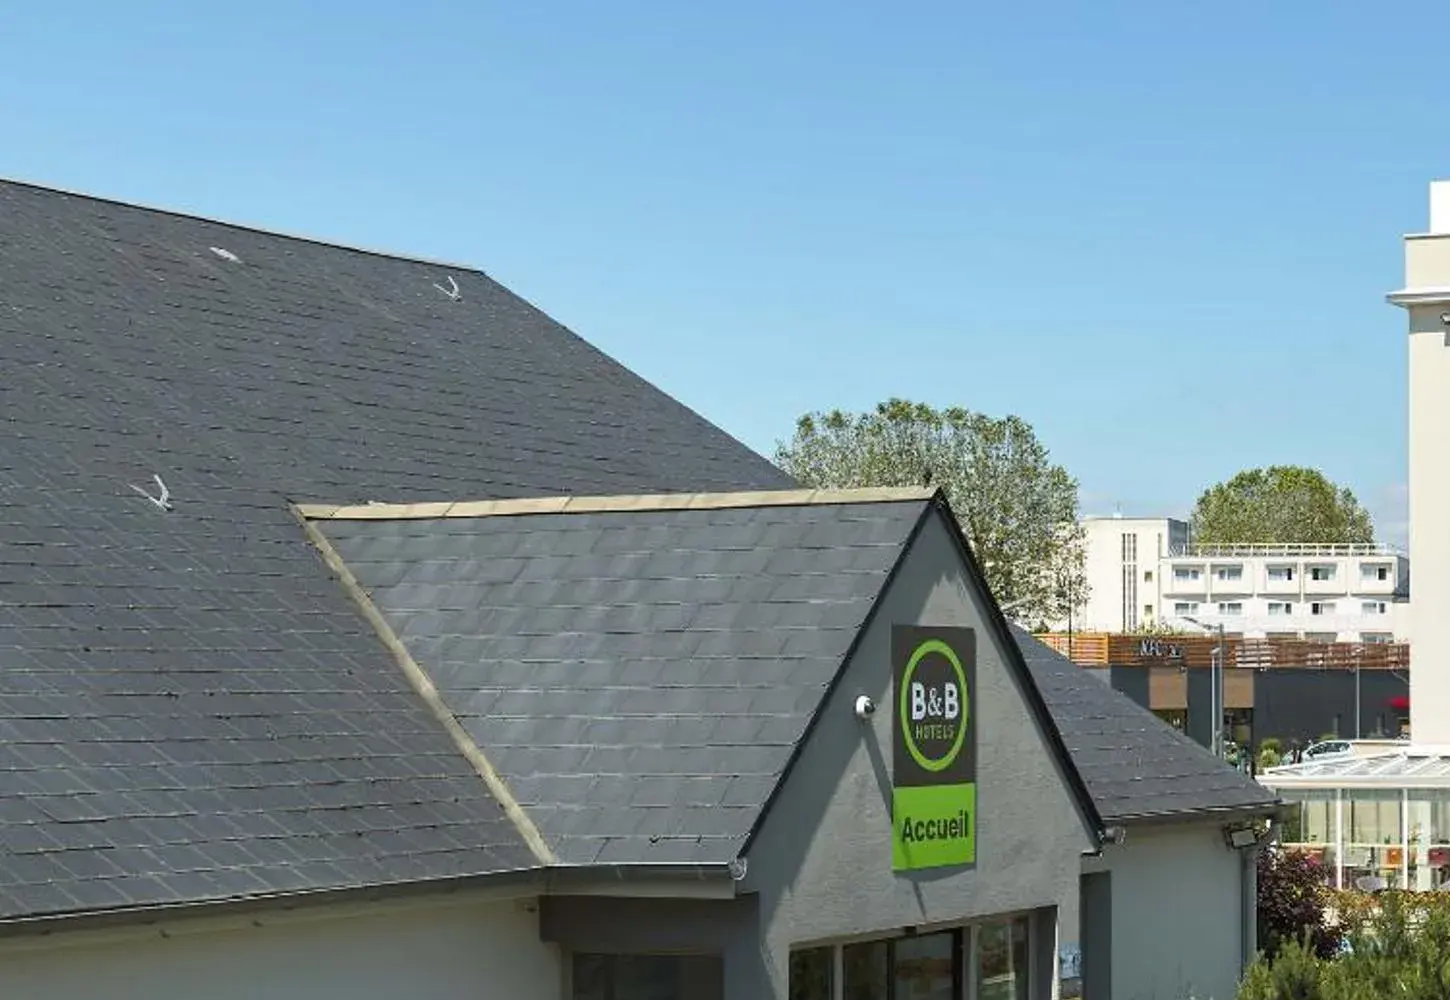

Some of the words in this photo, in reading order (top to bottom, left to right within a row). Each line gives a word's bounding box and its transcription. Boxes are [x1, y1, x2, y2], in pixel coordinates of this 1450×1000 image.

[911, 681, 959, 721] B&B
[915, 724, 955, 740] HOTELS
[902, 809, 969, 843] Accueil
